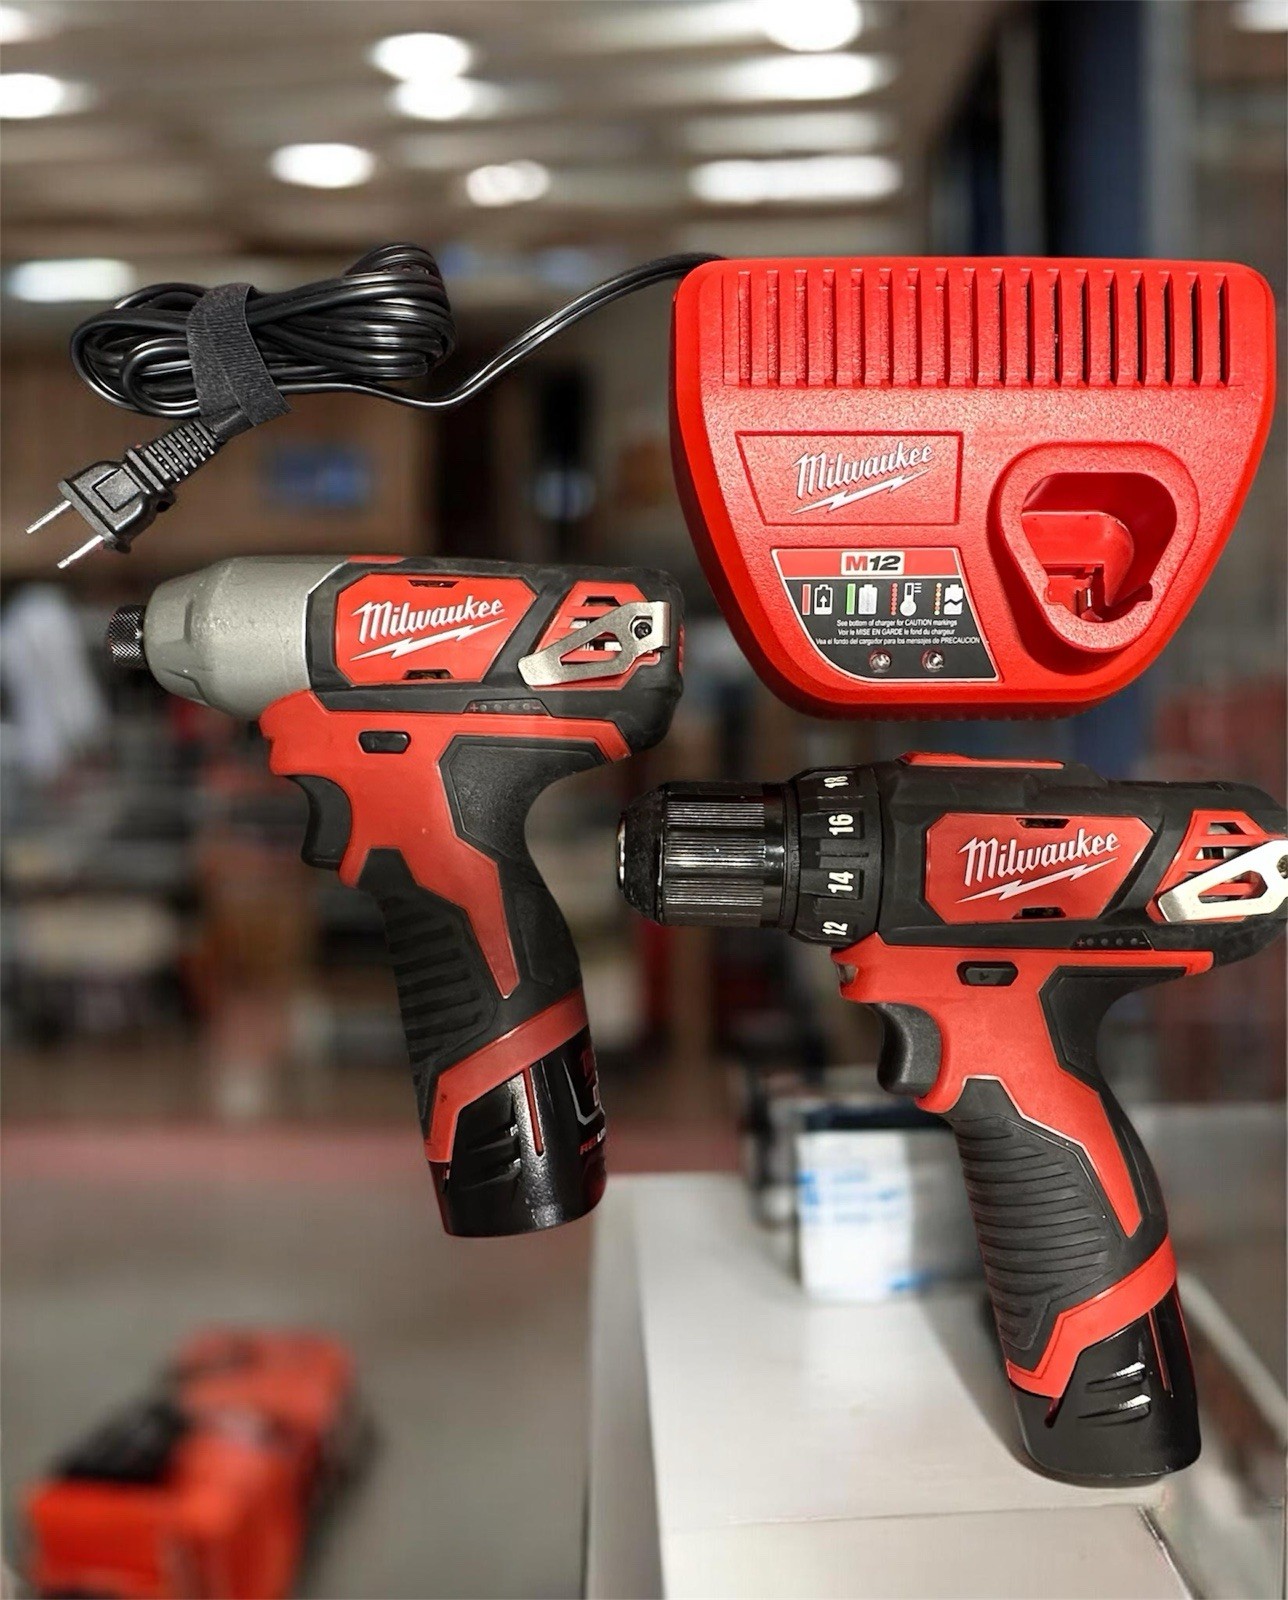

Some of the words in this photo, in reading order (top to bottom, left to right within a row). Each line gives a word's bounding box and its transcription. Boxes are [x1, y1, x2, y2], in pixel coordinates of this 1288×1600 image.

[792, 441, 934, 500] Milwaukee
[845, 554, 901, 571] M12
[351, 595, 505, 644] Milwaukee
[904, 619, 932, 627] CAUTION
[856, 628, 871, 636] MISE
[872, 628, 881, 636] EN
[881, 628, 903, 636] GARDE
[824, 776, 849, 788] 18
[828, 814, 854, 836] 16
[957, 828, 1121, 887] Milwaukee
[828, 871, 854, 893] 14
[822, 921, 849, 936] 12
